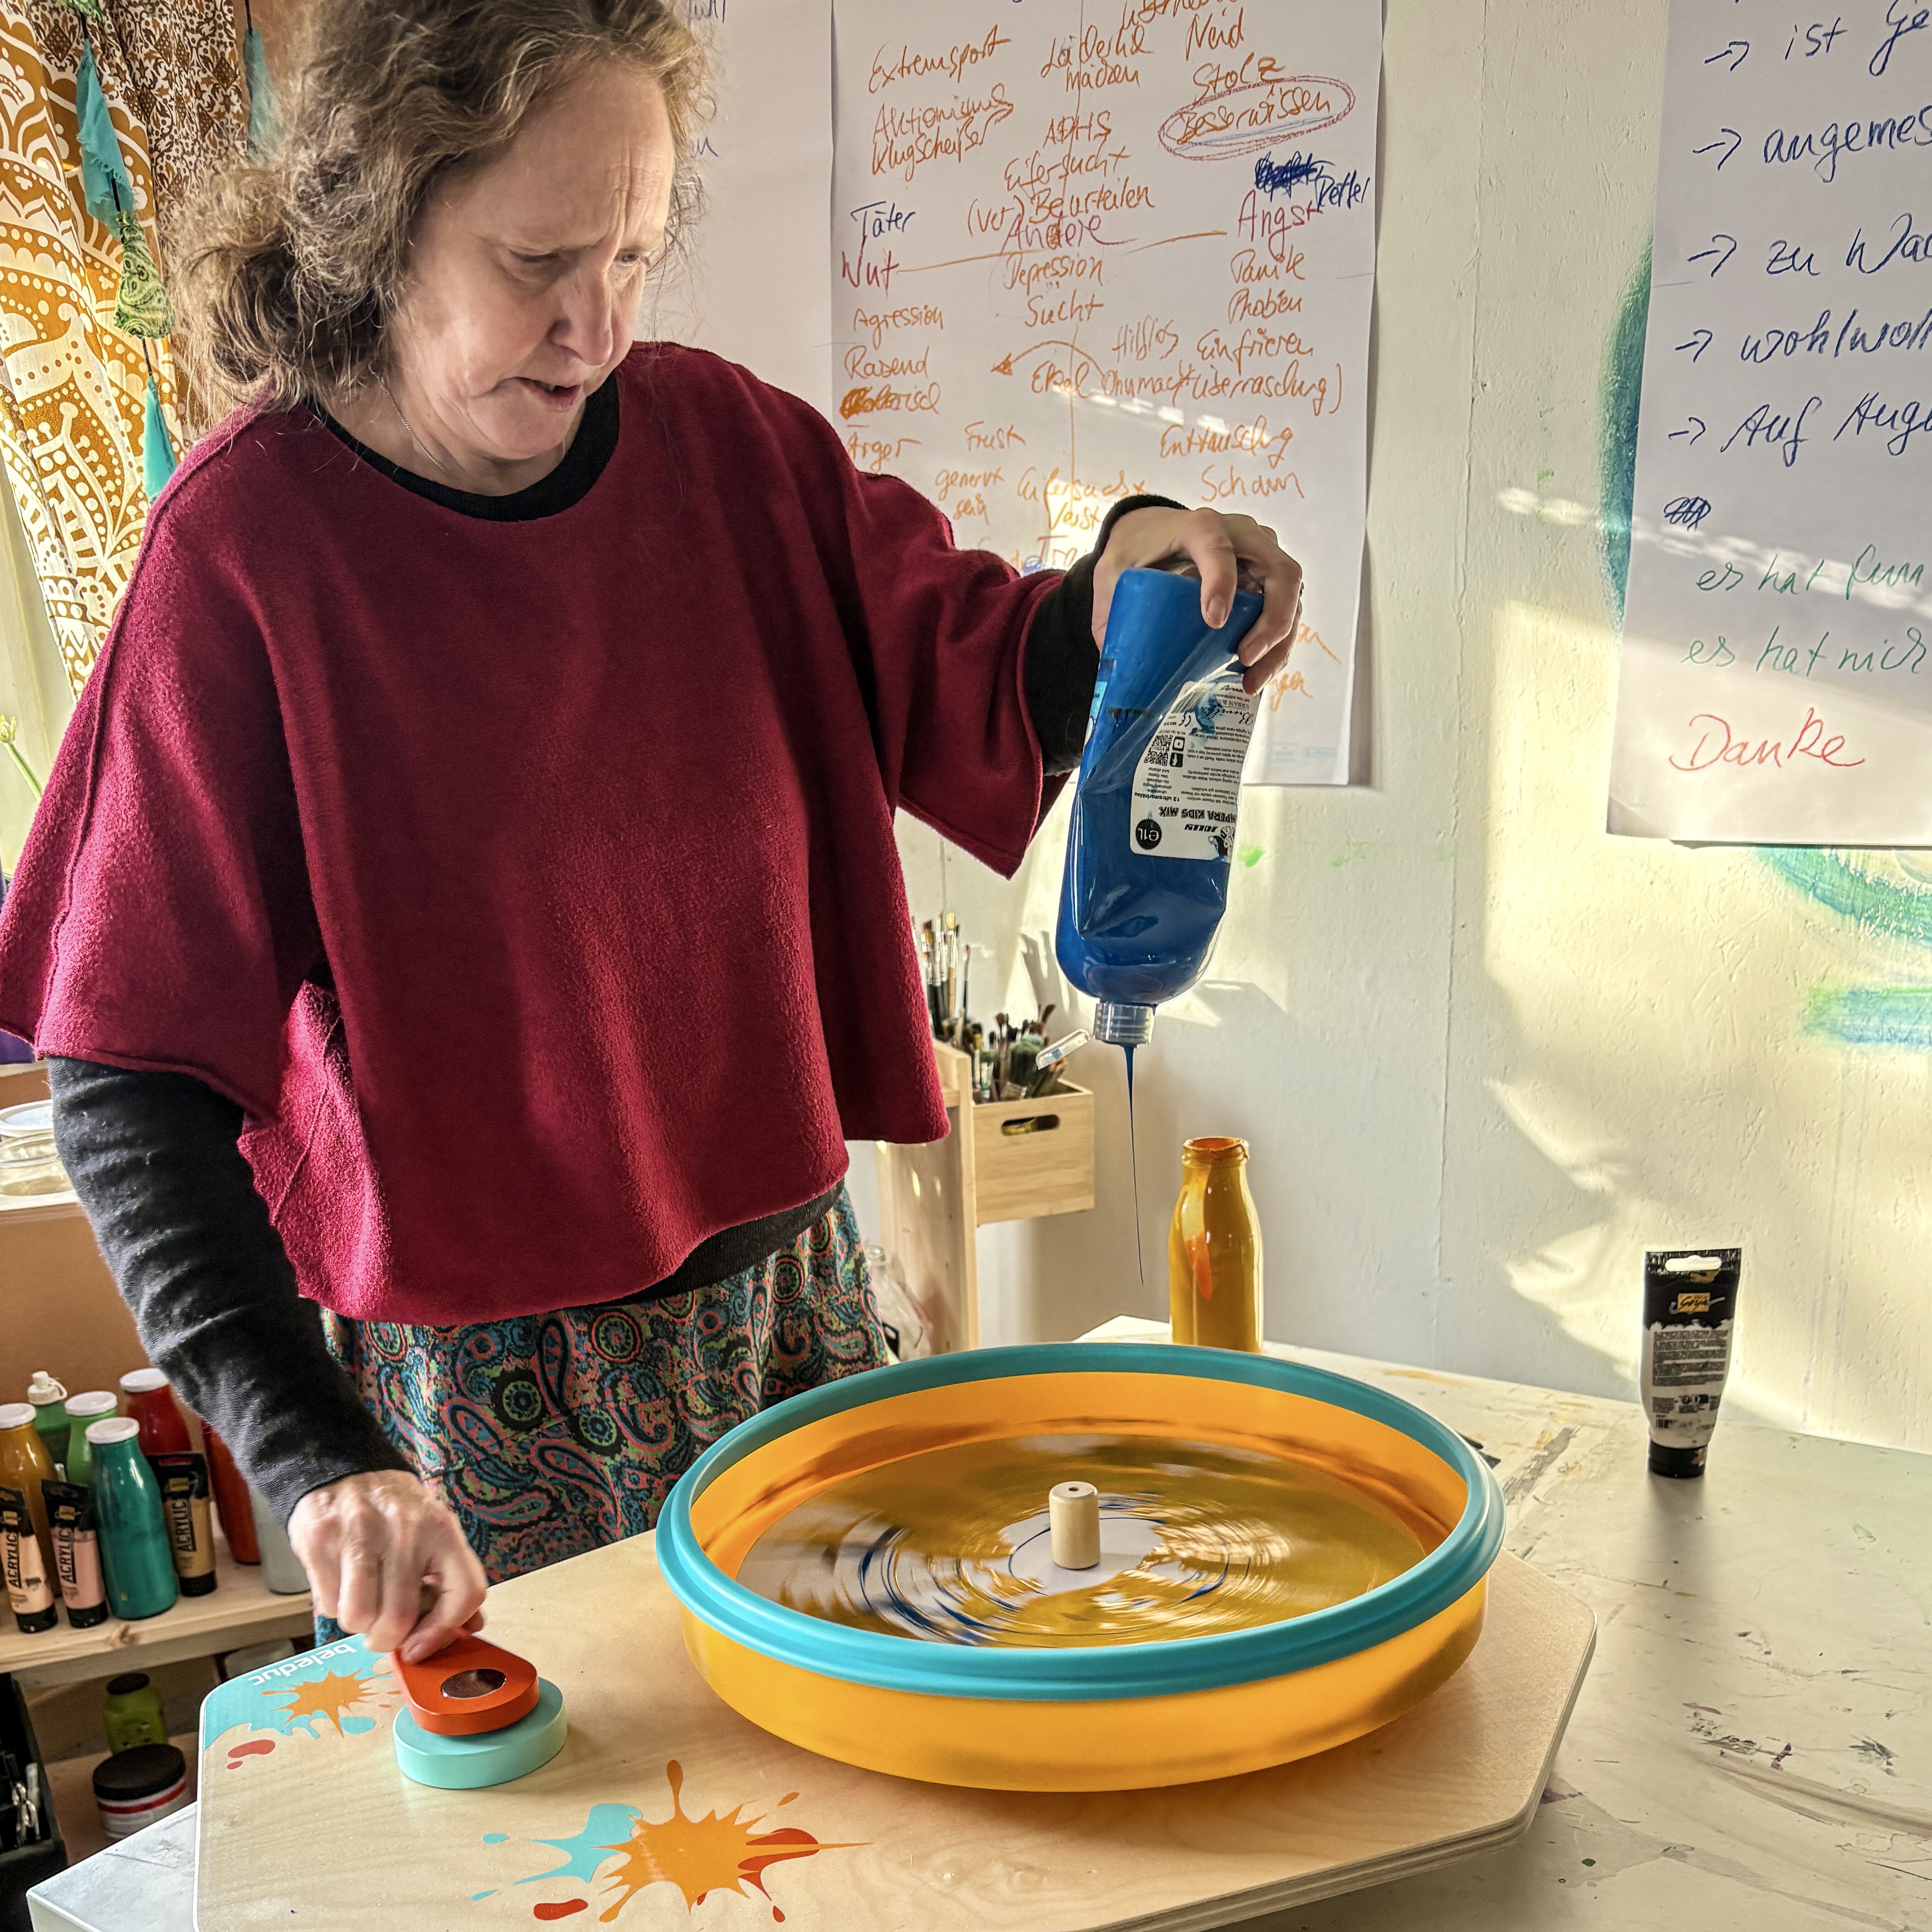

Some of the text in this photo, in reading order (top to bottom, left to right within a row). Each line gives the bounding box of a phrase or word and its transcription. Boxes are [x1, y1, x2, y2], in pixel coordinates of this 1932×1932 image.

[1186, 7, 1244, 61] Neid
[1784, 16, 1848, 61] ist
[1044, 111, 1112, 147] ADHS
[851, 201, 916, 238] Täter
[1238, 189, 1323, 262] Angst
[1766, 239, 1821, 276] zu
[1025, 289, 1104, 327] Sucht
[844, 345, 929, 380] Rasend
[1720, 396, 1822, 468] Auf
[1696, 562, 1744, 591] es
[1758, 554, 1827, 595] hat
[1680, 636, 1736, 668] es
[1756, 626, 1829, 677] hat
[1669, 707, 1866, 771] Danke
[1159, 806, 1179, 818] MIX
[1181, 808, 1205, 819] KIDS
[172, 1499, 193, 1552] ACRYLIC
[6, 1532, 18, 1588] ACRYLIC
[59, 1530, 73, 1583] ACRYLIC
[248, 1643, 358, 1686] beleduc
